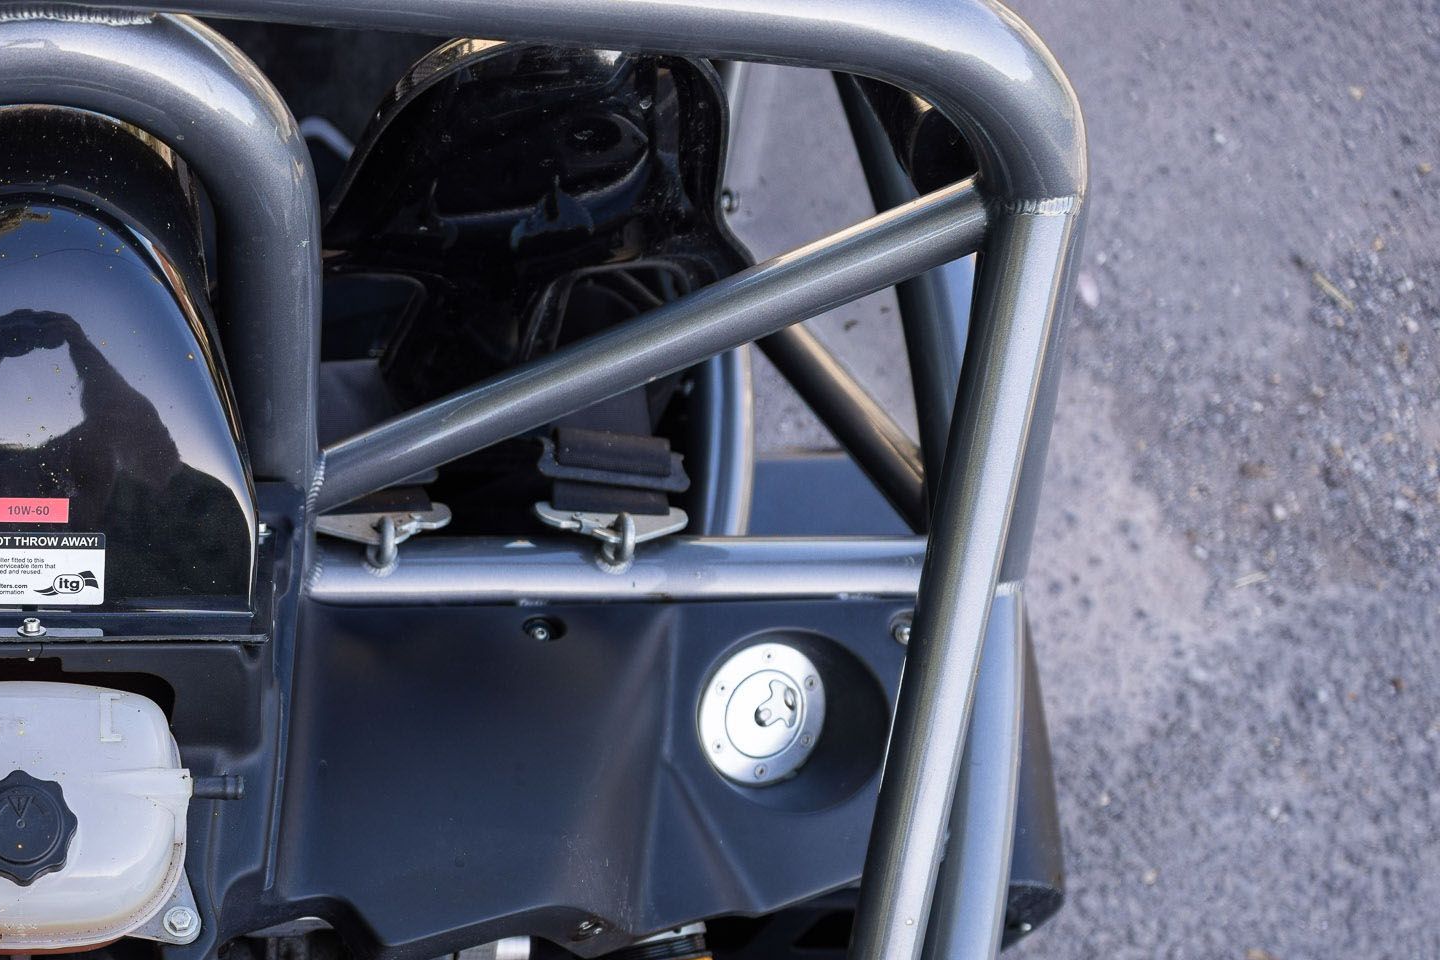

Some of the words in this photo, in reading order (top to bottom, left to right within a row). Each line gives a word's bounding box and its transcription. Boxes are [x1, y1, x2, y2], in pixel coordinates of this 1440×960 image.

[7, 505, 50, 516] 10W-60
[14, 536, 59, 547] THROW
[60, 536, 98, 547] AWAY!
[58, 577, 80, 592] itg
